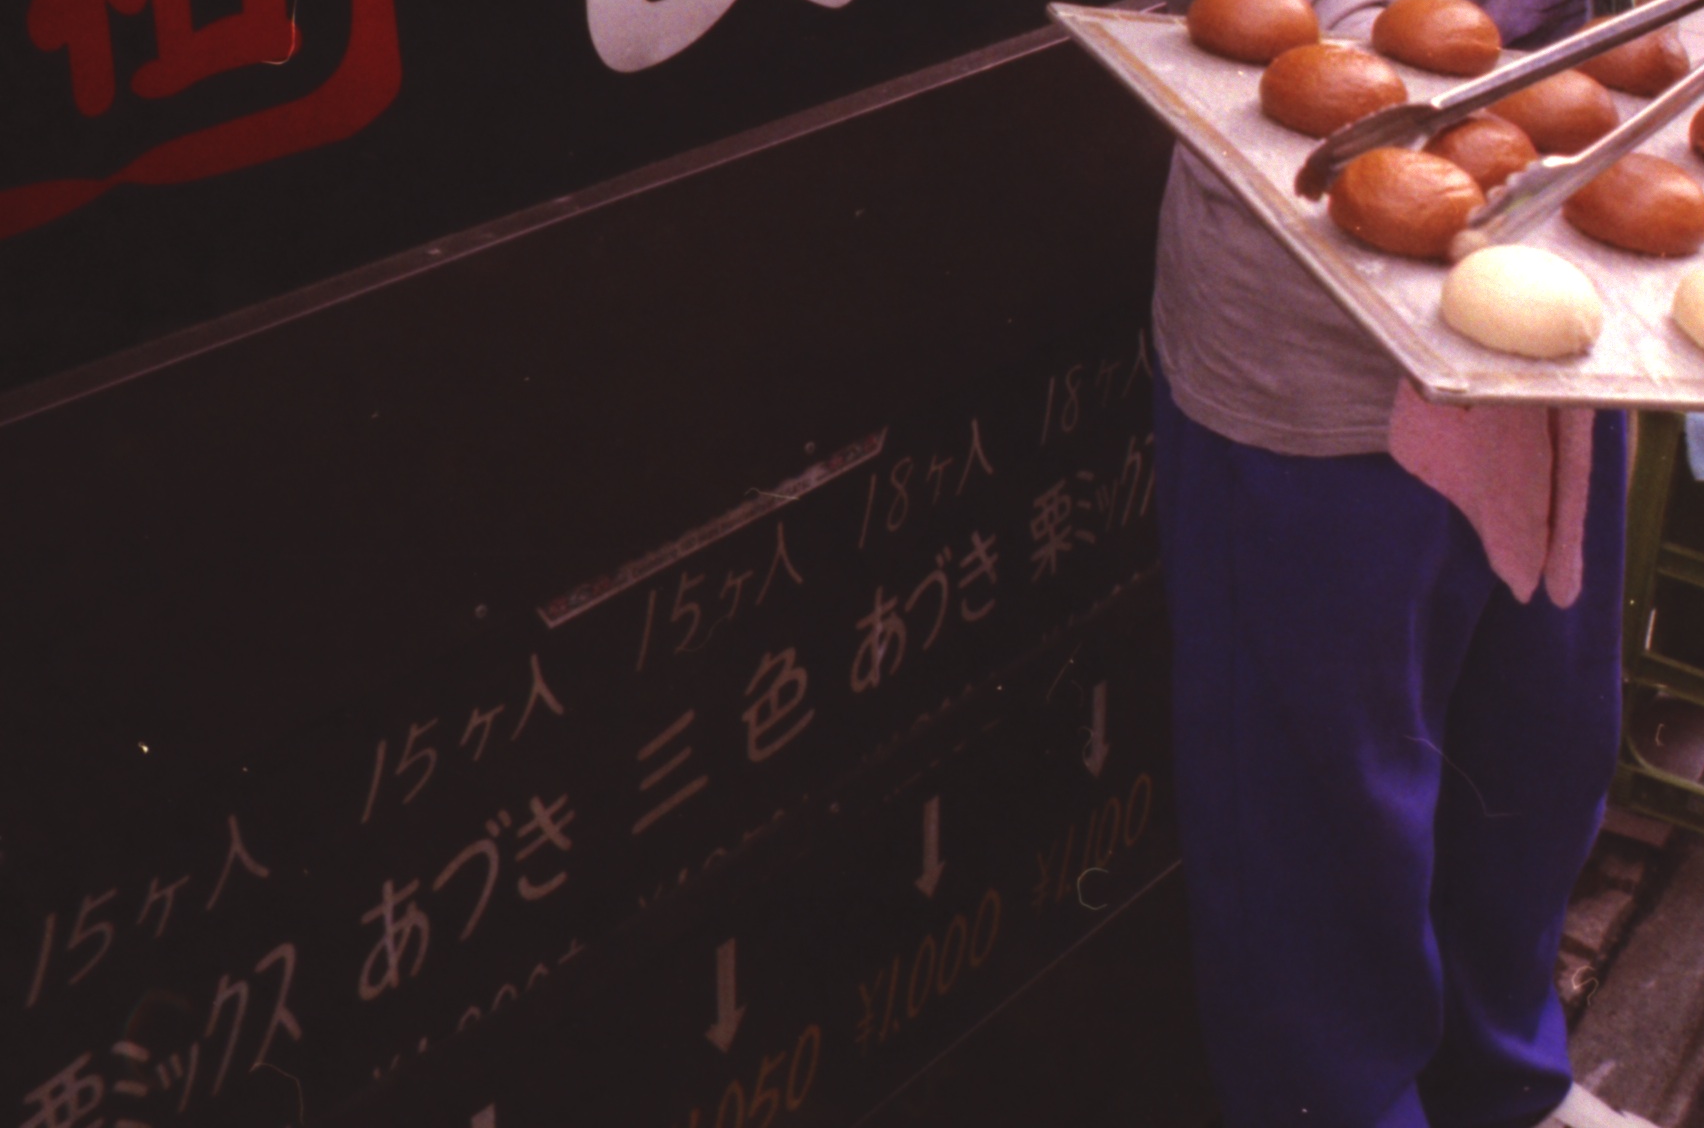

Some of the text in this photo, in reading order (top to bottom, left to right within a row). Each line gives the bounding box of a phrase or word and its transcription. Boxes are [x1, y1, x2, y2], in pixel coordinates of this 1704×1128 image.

[1030, 432, 1155, 584] 栗ミック
[850, 530, 1000, 693] あづき
[631, 648, 816, 836] 三色
[358, 792, 578, 1002] あづき
